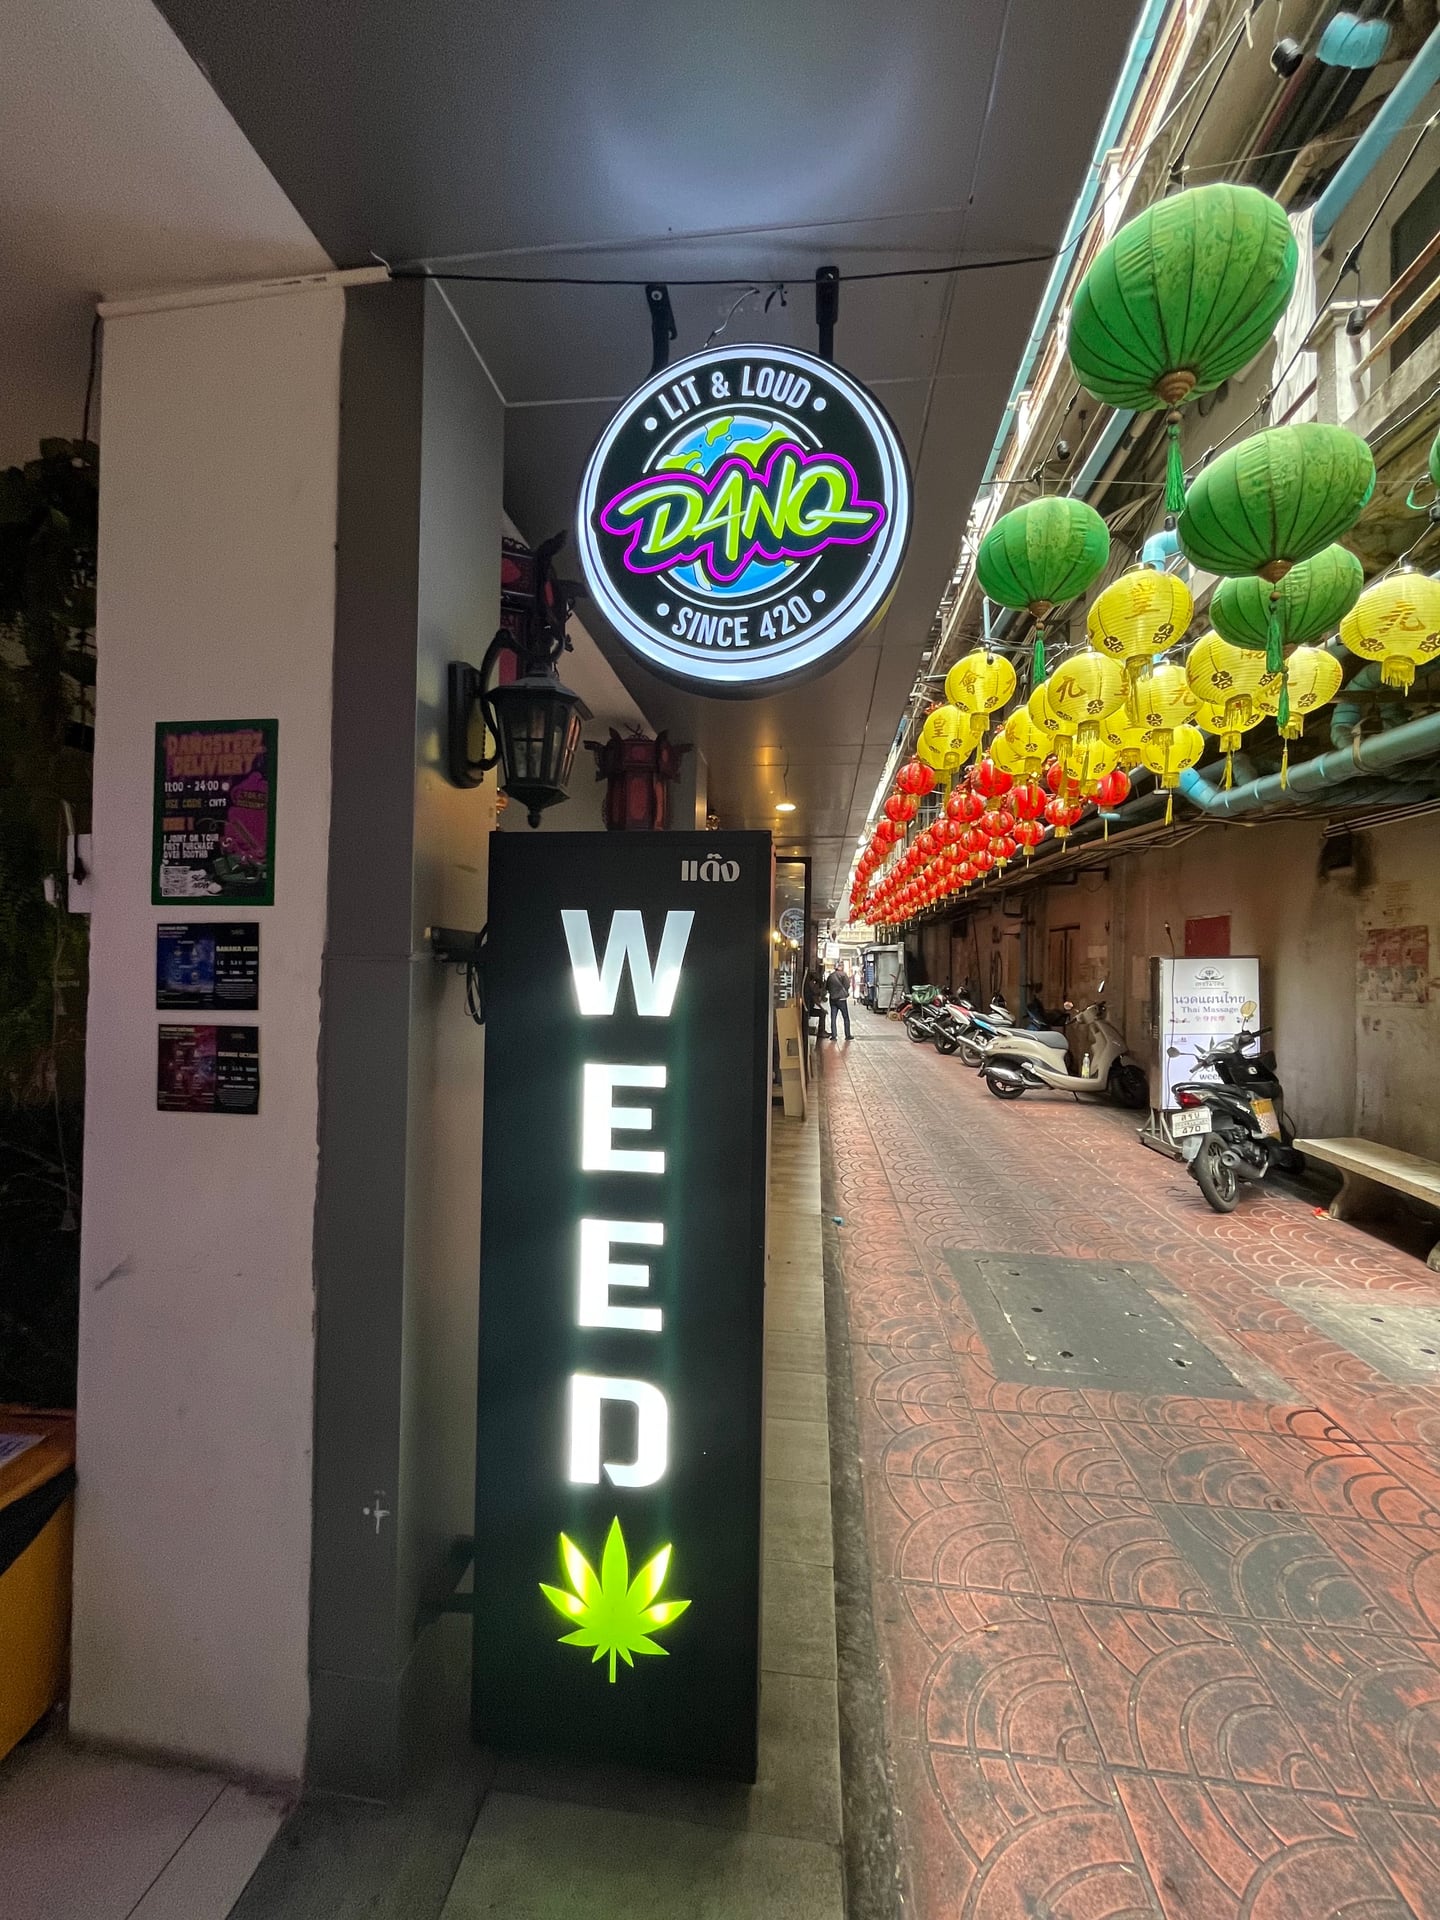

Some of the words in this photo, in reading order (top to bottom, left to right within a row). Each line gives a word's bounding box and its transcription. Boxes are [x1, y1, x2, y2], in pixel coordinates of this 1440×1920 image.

[659, 376, 702, 420] LIT
[712, 371, 731, 398] &
[741, 365, 811, 410] LOUD
[671, 606, 750, 646] SINCE
[759, 596, 811, 640] 420
[1174, 991, 1246, 1004] นวดแผนไทย
[1181, 1006, 1201, 1014] Thai
[1203, 1006, 1239, 1015] Massage
[1182, 1125, 1201, 1134] 470
[558, 908, 696, 1488] WEED
